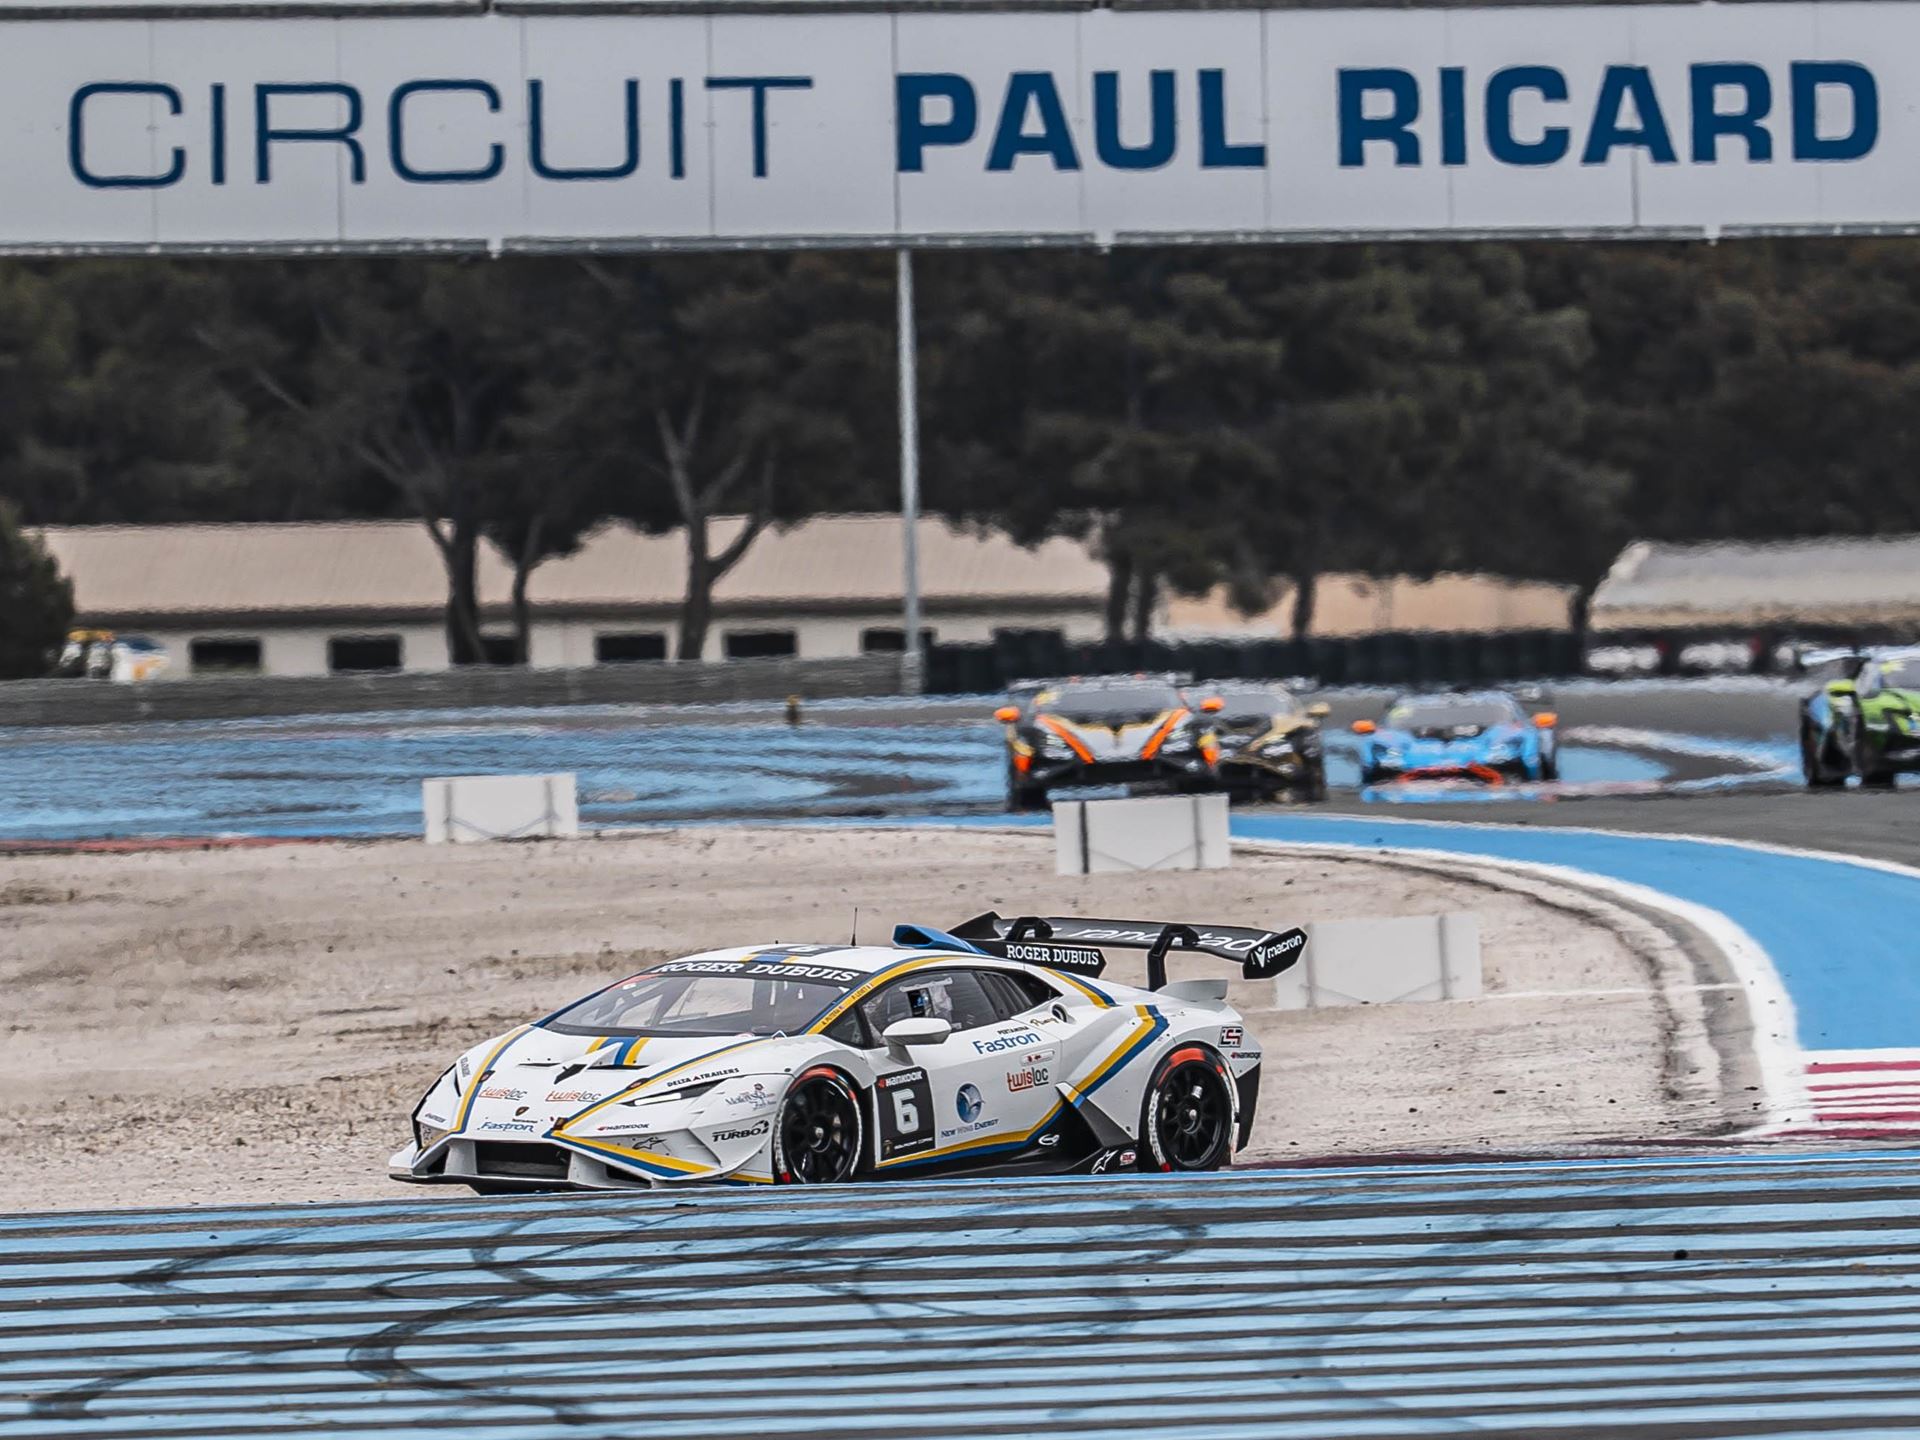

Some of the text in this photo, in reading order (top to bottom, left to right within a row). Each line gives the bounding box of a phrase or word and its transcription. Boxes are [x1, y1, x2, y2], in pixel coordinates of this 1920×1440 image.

[68, 60, 1879, 188] CIRCUIT PAUL RICARD
[1006, 944, 1099, 966] ROGER DUBUIS
[1266, 934, 1303, 959] macron
[650, 962, 860, 982] ROGER DUBUIS
[973, 1032, 1042, 1055] Fastron
[666, 1067, 740, 1088] DELTA TRAILERS
[1007, 1066, 1049, 1092] twisloc
[892, 1088, 920, 1135] 6
[481, 1121, 535, 1133] Fastron
